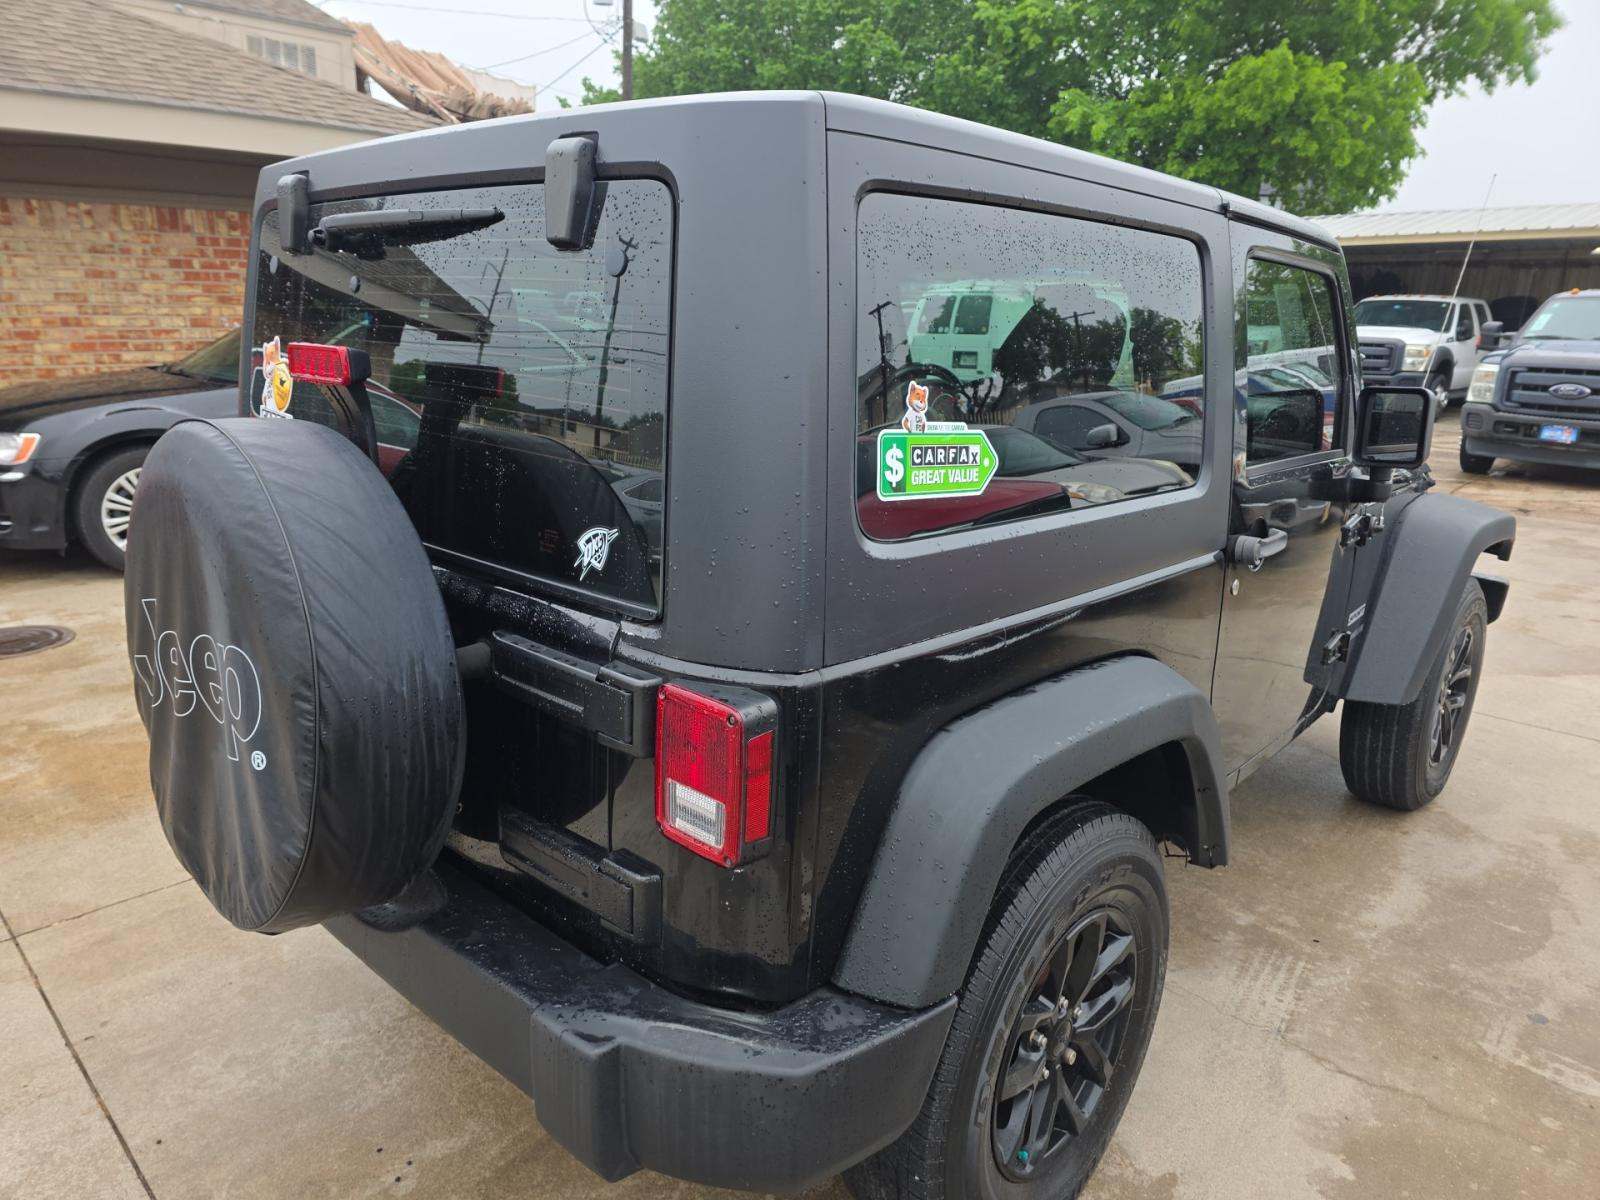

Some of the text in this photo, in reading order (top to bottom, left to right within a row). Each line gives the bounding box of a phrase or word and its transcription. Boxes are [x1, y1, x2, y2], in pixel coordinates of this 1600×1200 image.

[912, 446, 979, 465] CARFAX
[911, 467, 979, 486] GREAT VALUE
[134, 599, 262, 762] Jeep
